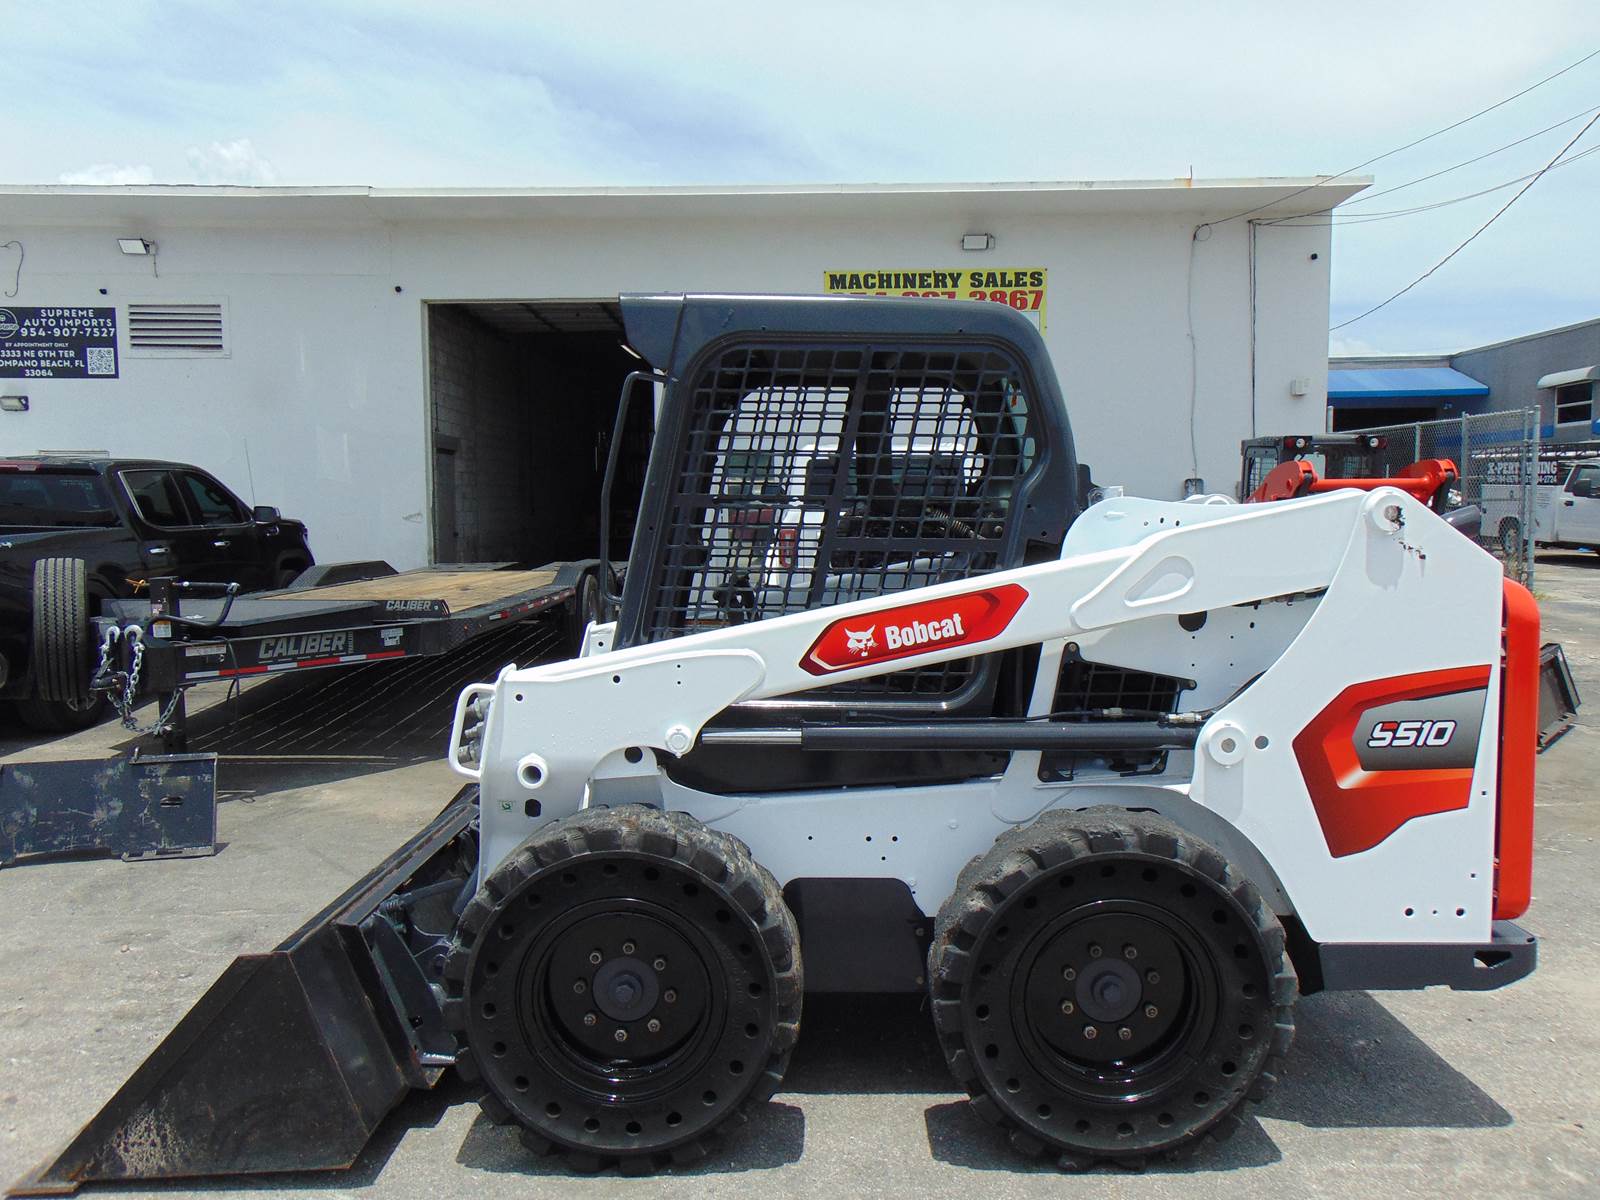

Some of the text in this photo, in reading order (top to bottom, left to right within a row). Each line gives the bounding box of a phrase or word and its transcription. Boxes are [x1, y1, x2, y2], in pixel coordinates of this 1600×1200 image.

[829, 271, 1043, 289] MACHINERY SALES
[40, 309, 95, 317] SUPREME
[23, 318, 57, 327] AUTO
[60, 318, 113, 327] IMPORTS
[20, 327, 116, 337] 954-907-7527
[24, 350, 35, 358] NE
[38, 350, 56, 358] 6TH
[58, 350, 76, 358] TER
[0, 359, 85, 369] OMPANO BEACH, FL
[25, 369, 53, 377] 33064
[386, 600, 431, 611] CALIBER
[885, 613, 964, 650] Bobcat
[259, 632, 347, 658] CALIBER
[1368, 720, 1457, 747] S510
